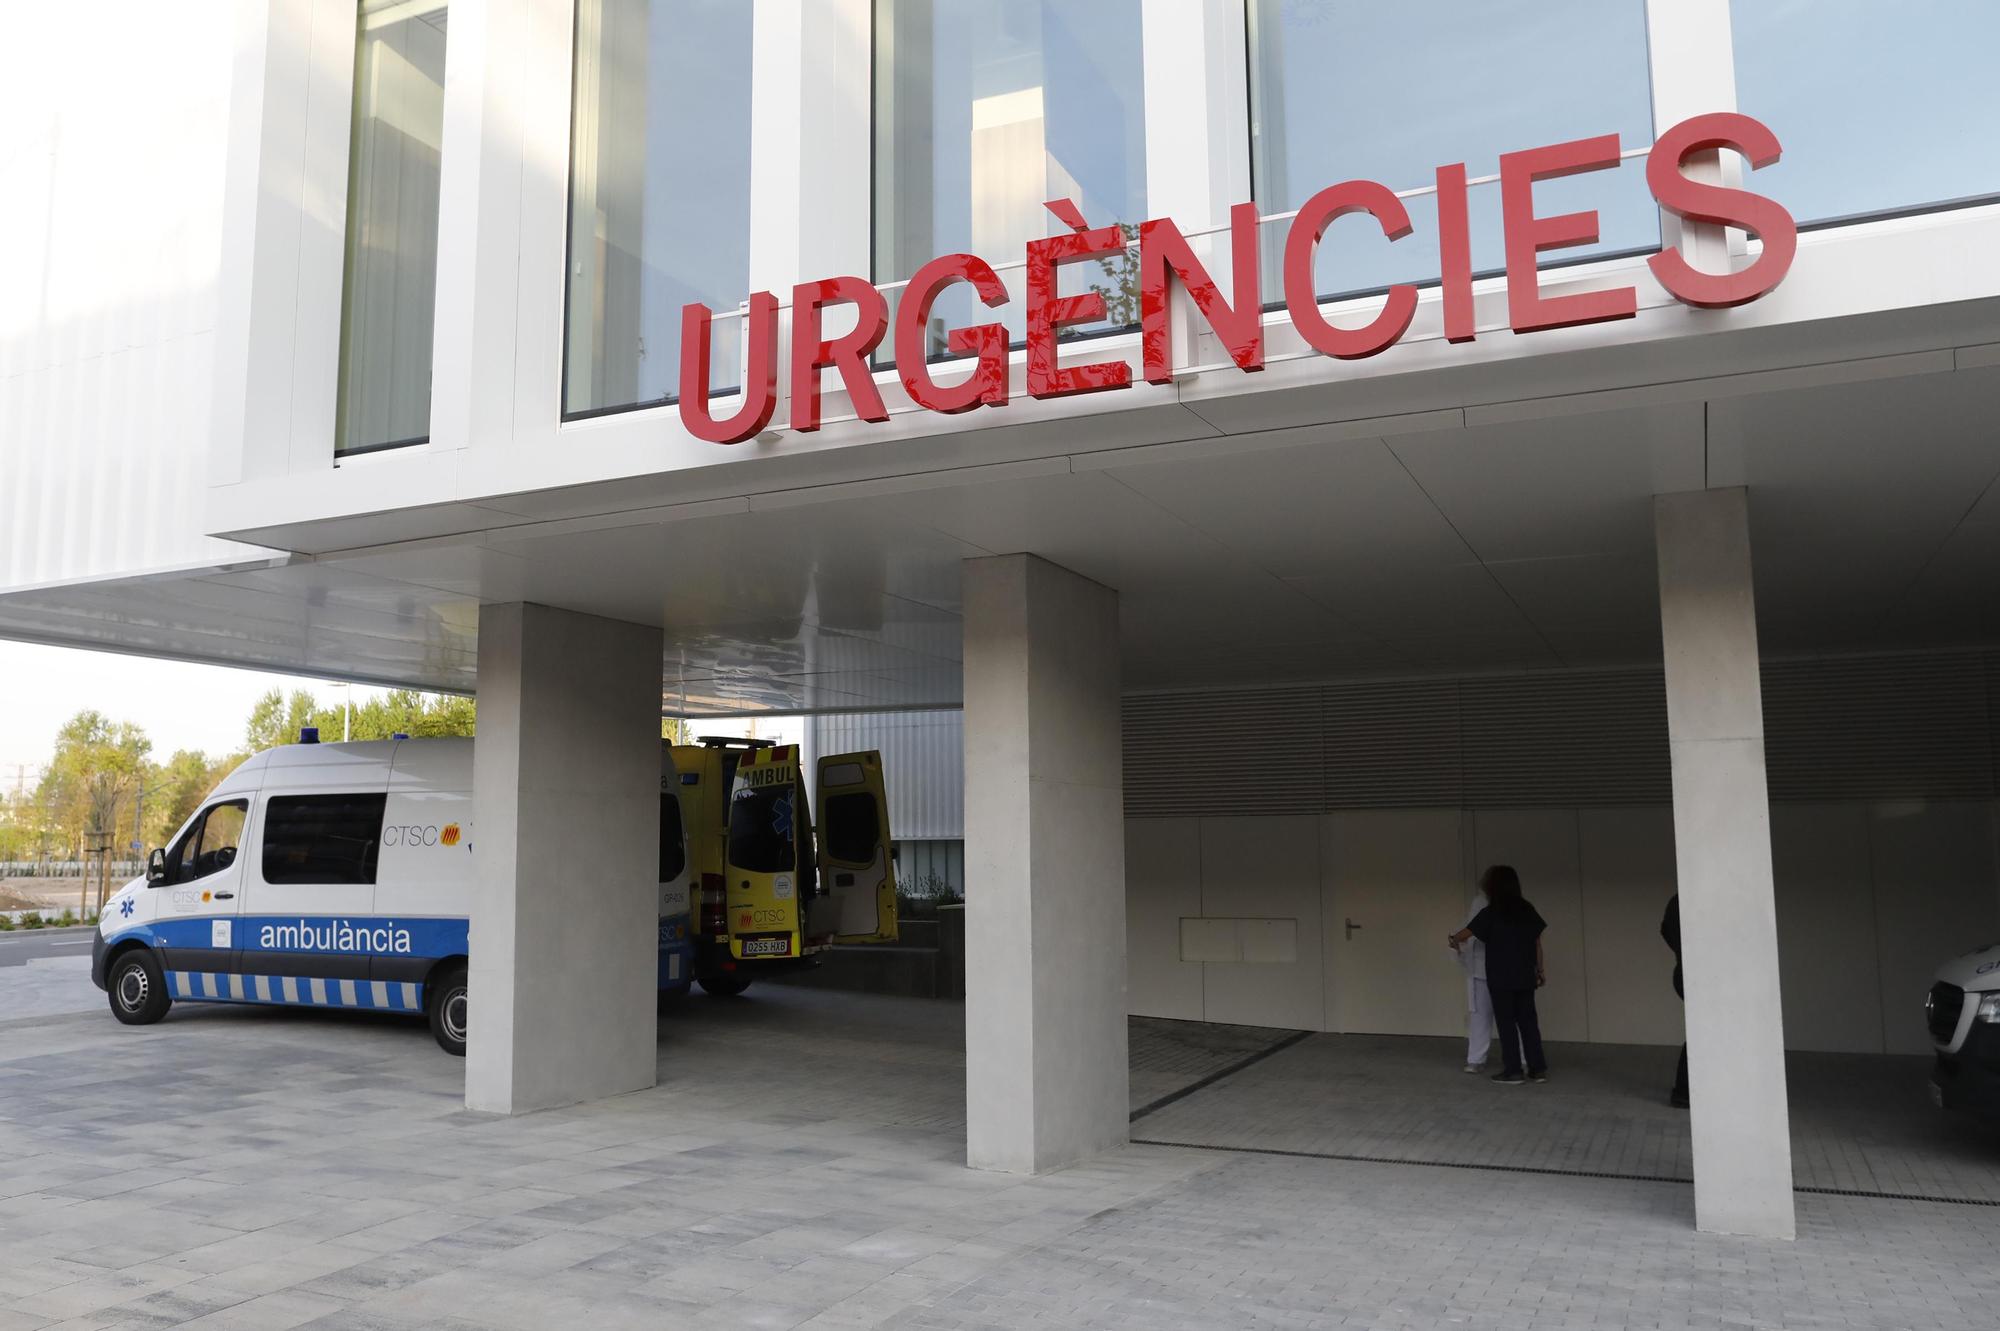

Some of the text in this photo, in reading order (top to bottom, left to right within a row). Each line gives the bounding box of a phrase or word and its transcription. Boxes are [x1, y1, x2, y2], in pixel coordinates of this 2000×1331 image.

[679, 111, 1797, 446] URGÈNCIES
[743, 766, 794, 787] AMBUL
[383, 825, 438, 847] CTSC
[172, 890, 201, 904] CTSC
[754, 908, 786, 923] CTSC
[260, 919, 411, 953] ambulància
[748, 941, 786, 953] 0255 HXB
